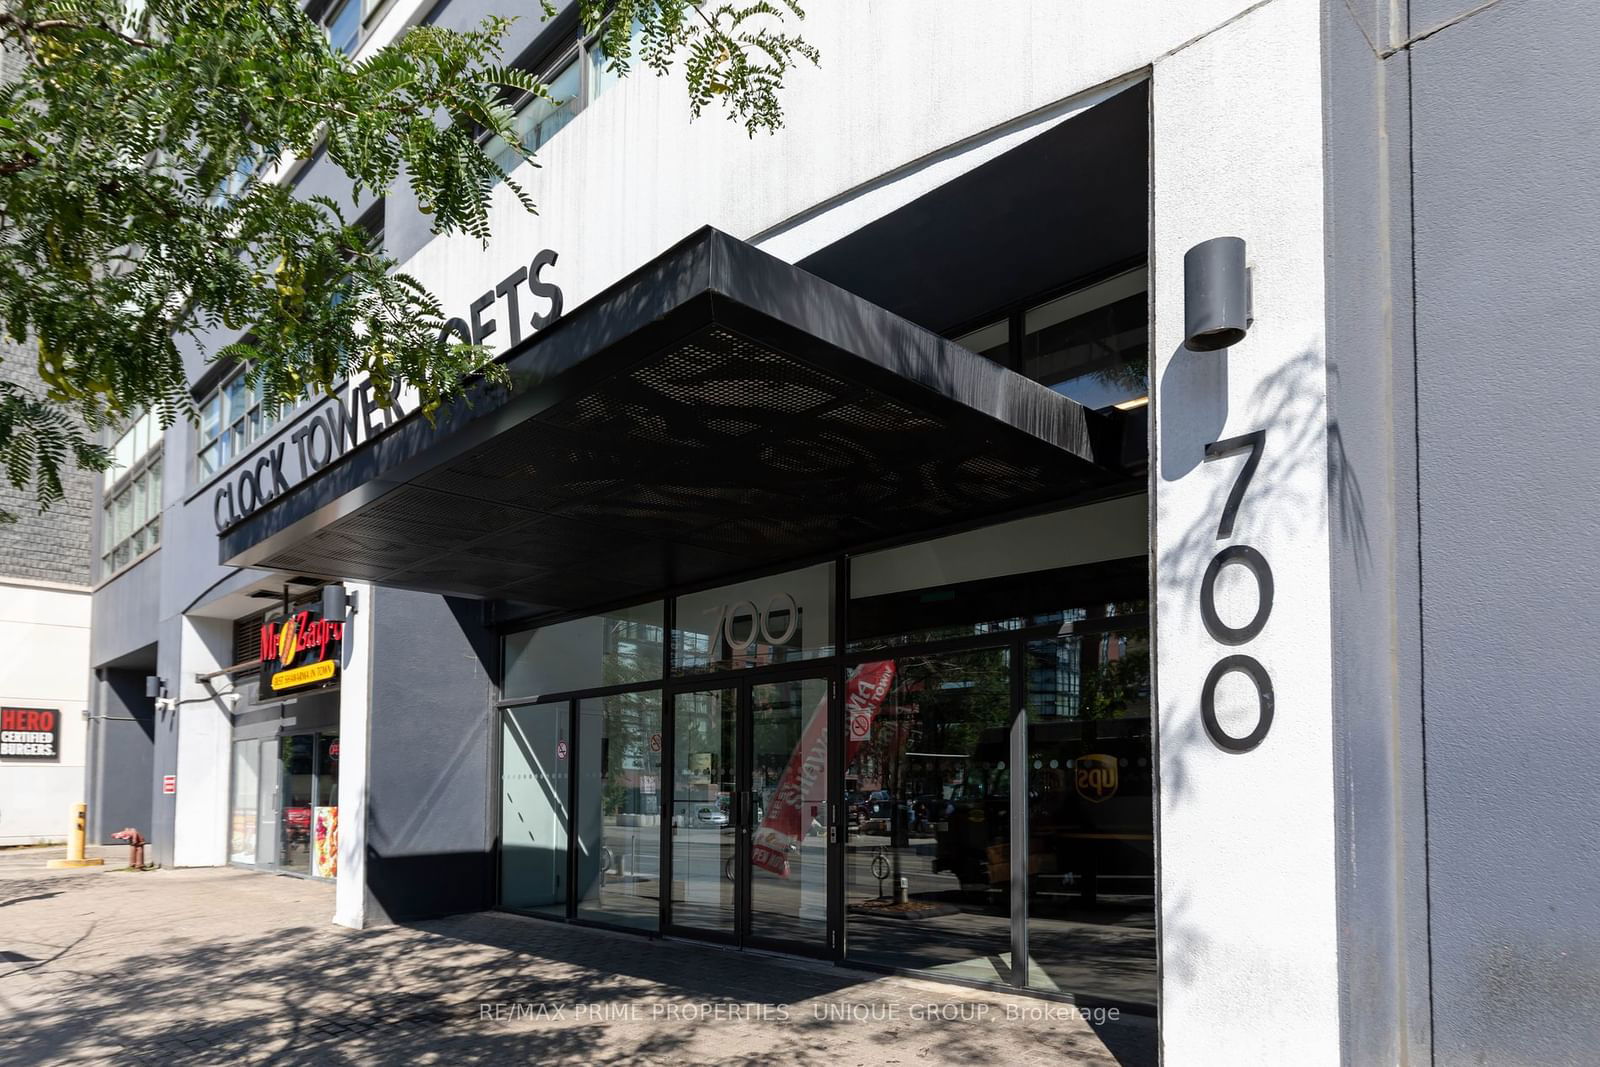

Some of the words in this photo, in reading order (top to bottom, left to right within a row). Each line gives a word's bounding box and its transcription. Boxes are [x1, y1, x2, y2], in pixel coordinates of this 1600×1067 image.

[213, 442, 290, 531] CLOCK
[292, 374, 406, 479] TOWER
[703, 592, 799, 655] 700
[1200, 429, 1275, 755] 700
[1, 731, 54, 743] CERTIFIED
[2, 709, 54, 731] HERO
